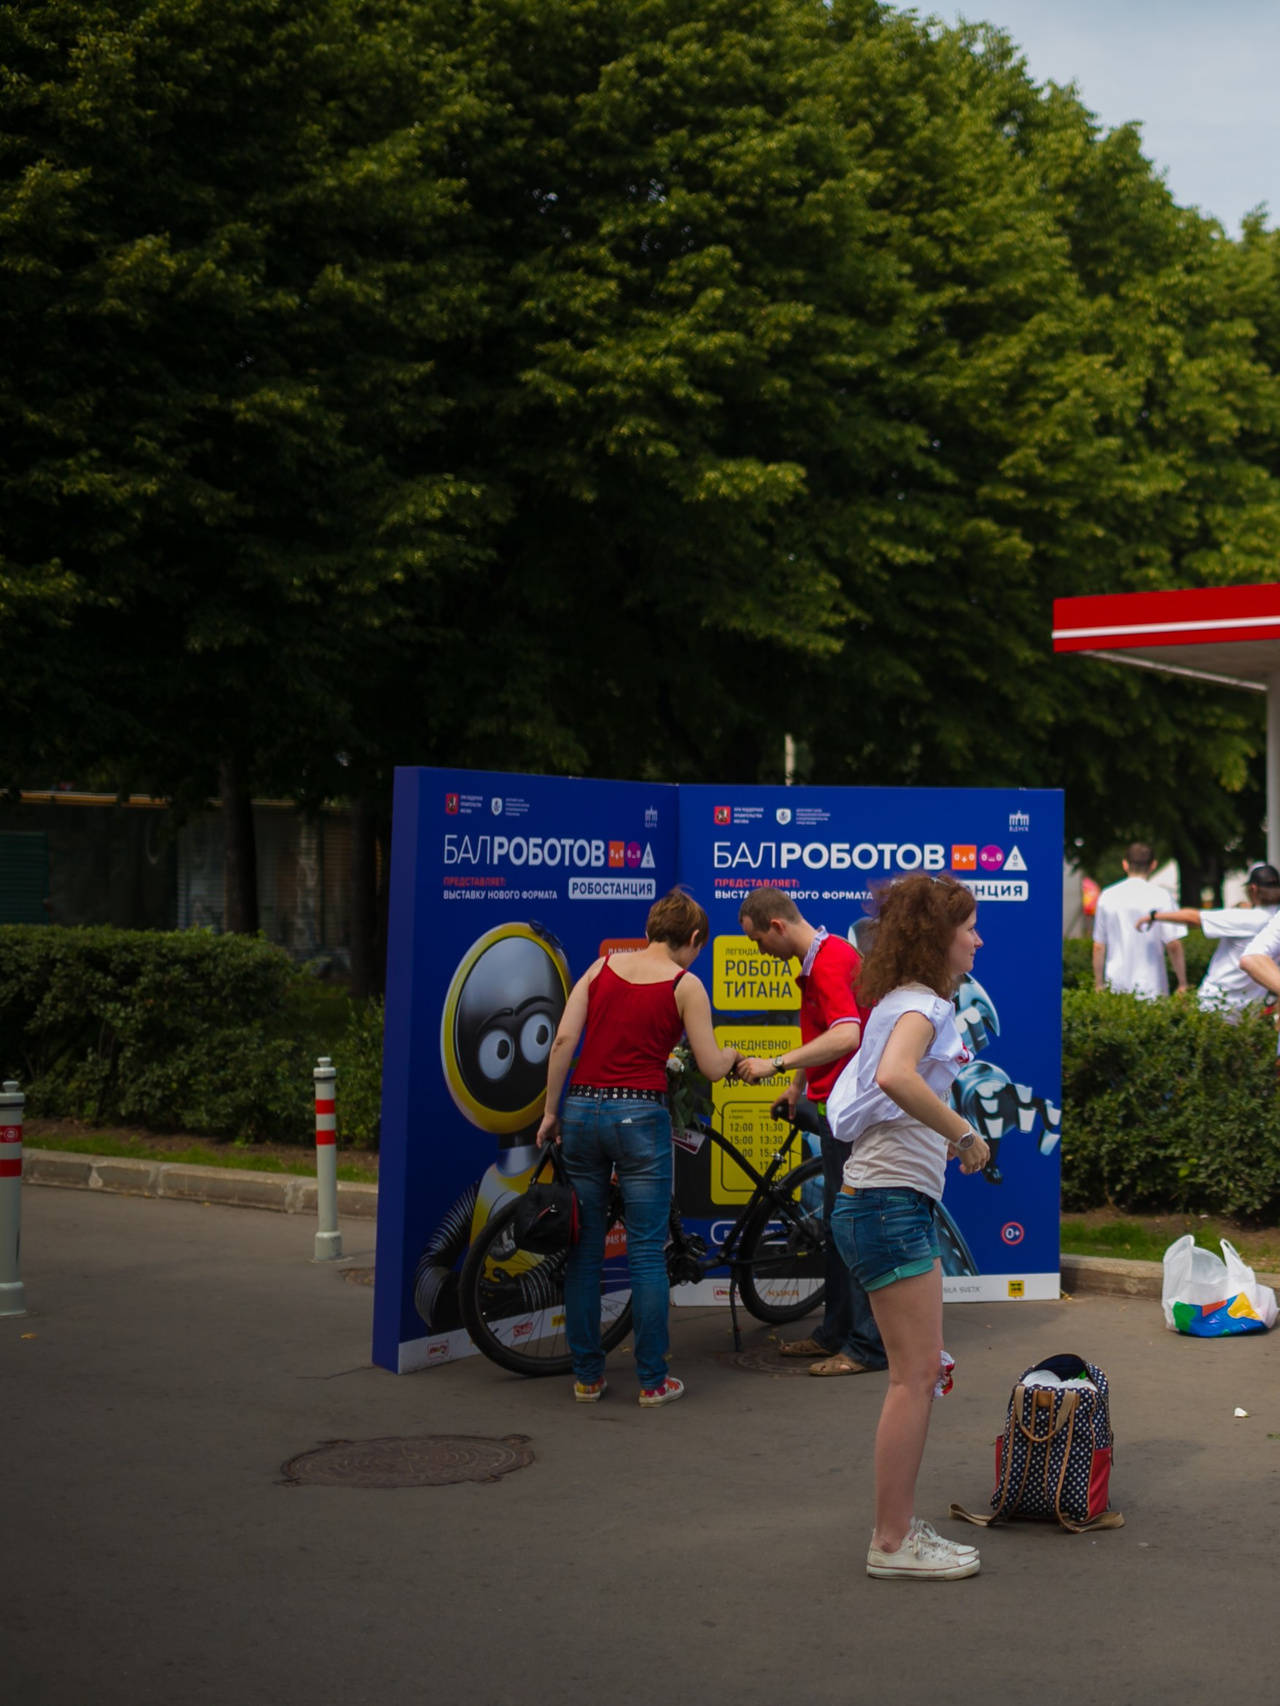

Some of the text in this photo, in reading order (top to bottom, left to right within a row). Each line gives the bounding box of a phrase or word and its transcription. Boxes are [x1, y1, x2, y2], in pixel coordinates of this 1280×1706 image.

[443, 876, 506, 887] ПРЕДСТАВЛЯЕТ:
[714, 878, 800, 889] ПРЕДСТАВЛЯЕТ:
[572, 882, 653, 896] РОБОСТАНЦИЯ
[443, 890, 558, 900] ВЫСТАВКУ НОВОГО ФОРМАТА
[822, 891, 873, 900] ФОРМАТА
[725, 960, 792, 977] РОБОТА
[724, 981, 792, 998] ТИТАНА
[724, 1040, 791, 1051] ЕЖЕДНЕВНО!
[730, 1123, 783, 1132] 12:00 11:30
[730, 1136, 783, 1145] 15:00 13:30
